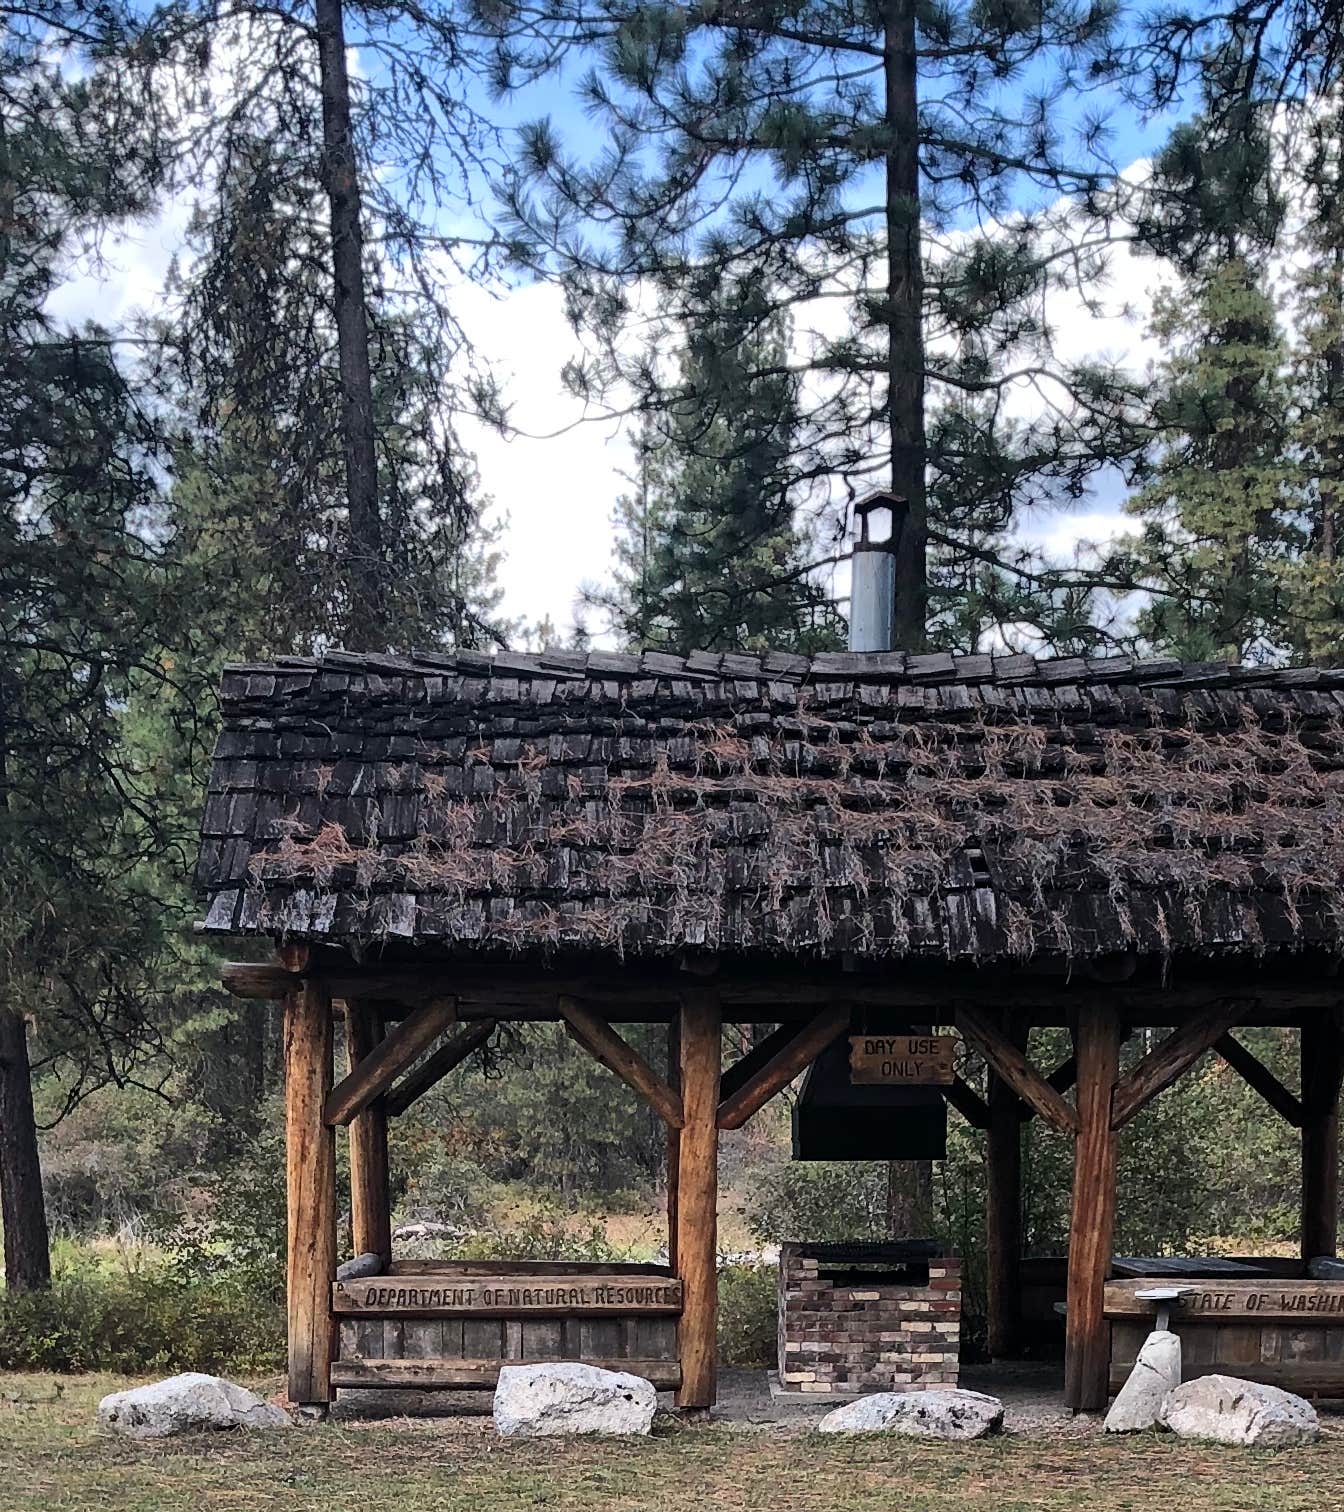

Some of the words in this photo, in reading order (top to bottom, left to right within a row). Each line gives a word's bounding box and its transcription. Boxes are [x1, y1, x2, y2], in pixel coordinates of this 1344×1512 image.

[864, 1040, 896, 1055] DAY
[909, 1040, 940, 1055] USE
[881, 1061, 924, 1077] ONLY
[365, 1287, 475, 1306] DEPARTMENT
[483, 1289, 504, 1306] OF
[508, 1288, 591, 1306] NATURAL
[595, 1286, 682, 1305] RESOURCES
[1246, 1293, 1270, 1310] OF
